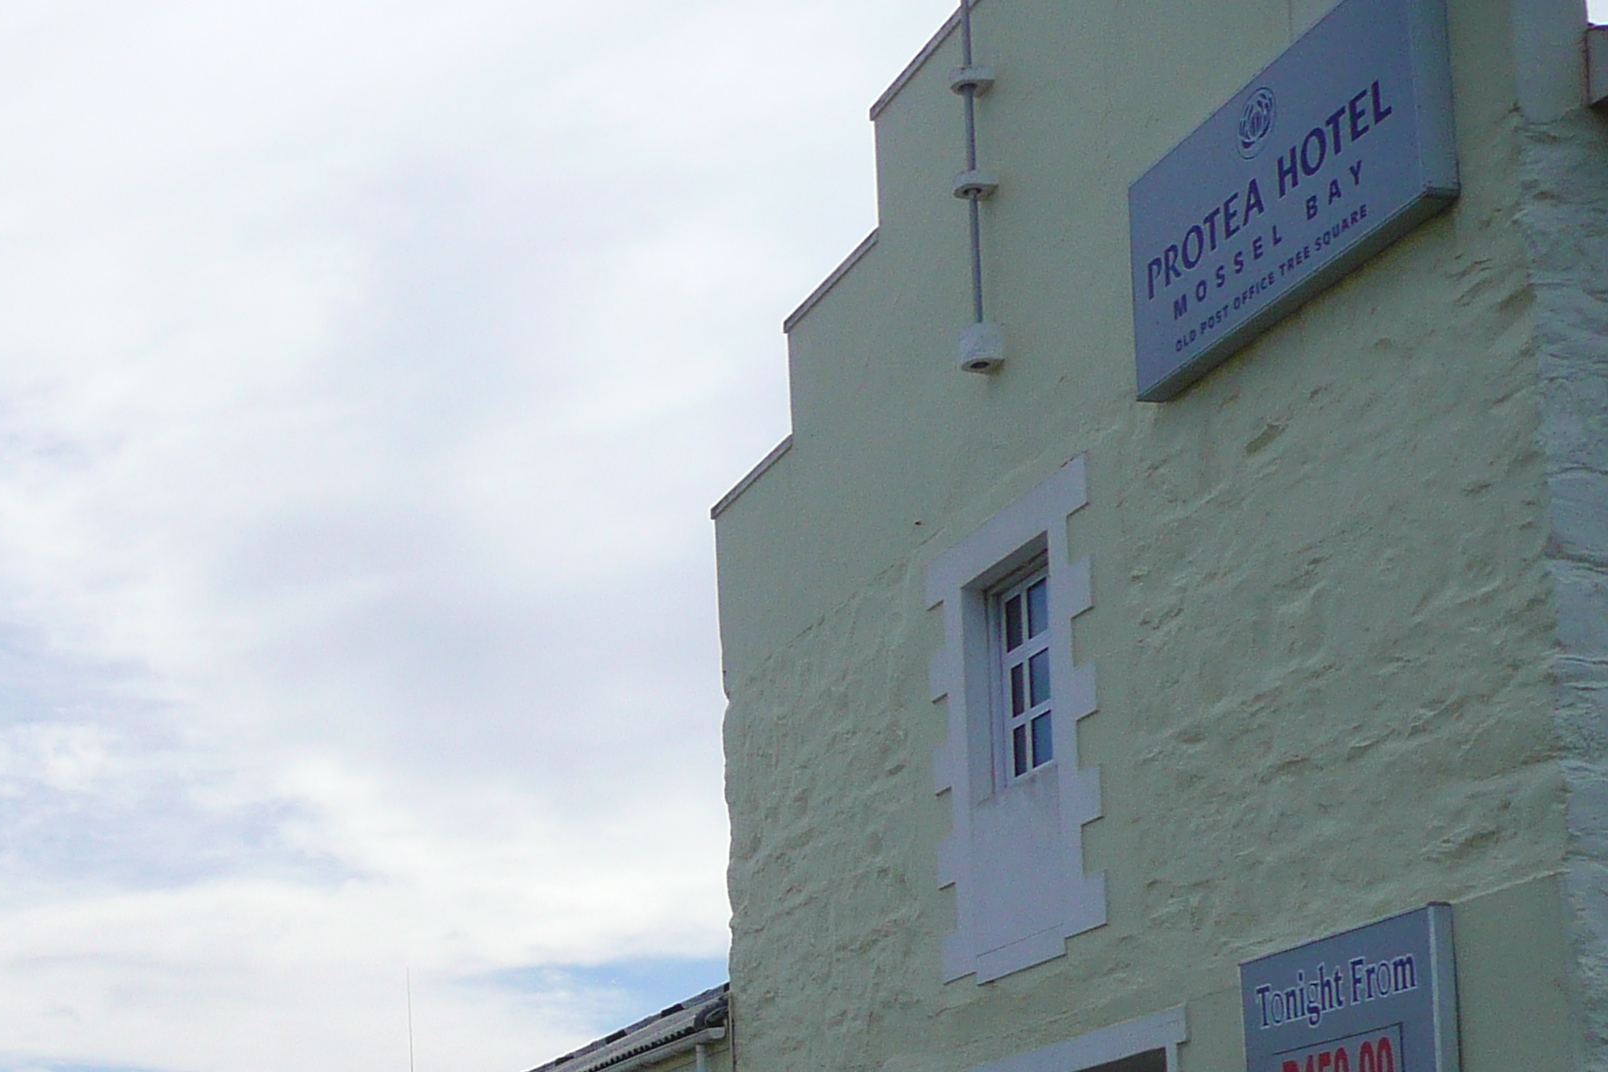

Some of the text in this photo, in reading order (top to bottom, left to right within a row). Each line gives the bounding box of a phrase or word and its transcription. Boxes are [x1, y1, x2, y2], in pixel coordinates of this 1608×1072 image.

[1147, 78, 1393, 300] PROTEA HOTEL
[1172, 159, 1363, 321] MOSSEL BAY
[1175, 203, 1369, 352] OLD POST OFFICE TREE SQUARE
[1255, 953, 1418, 1029] Tonight From
